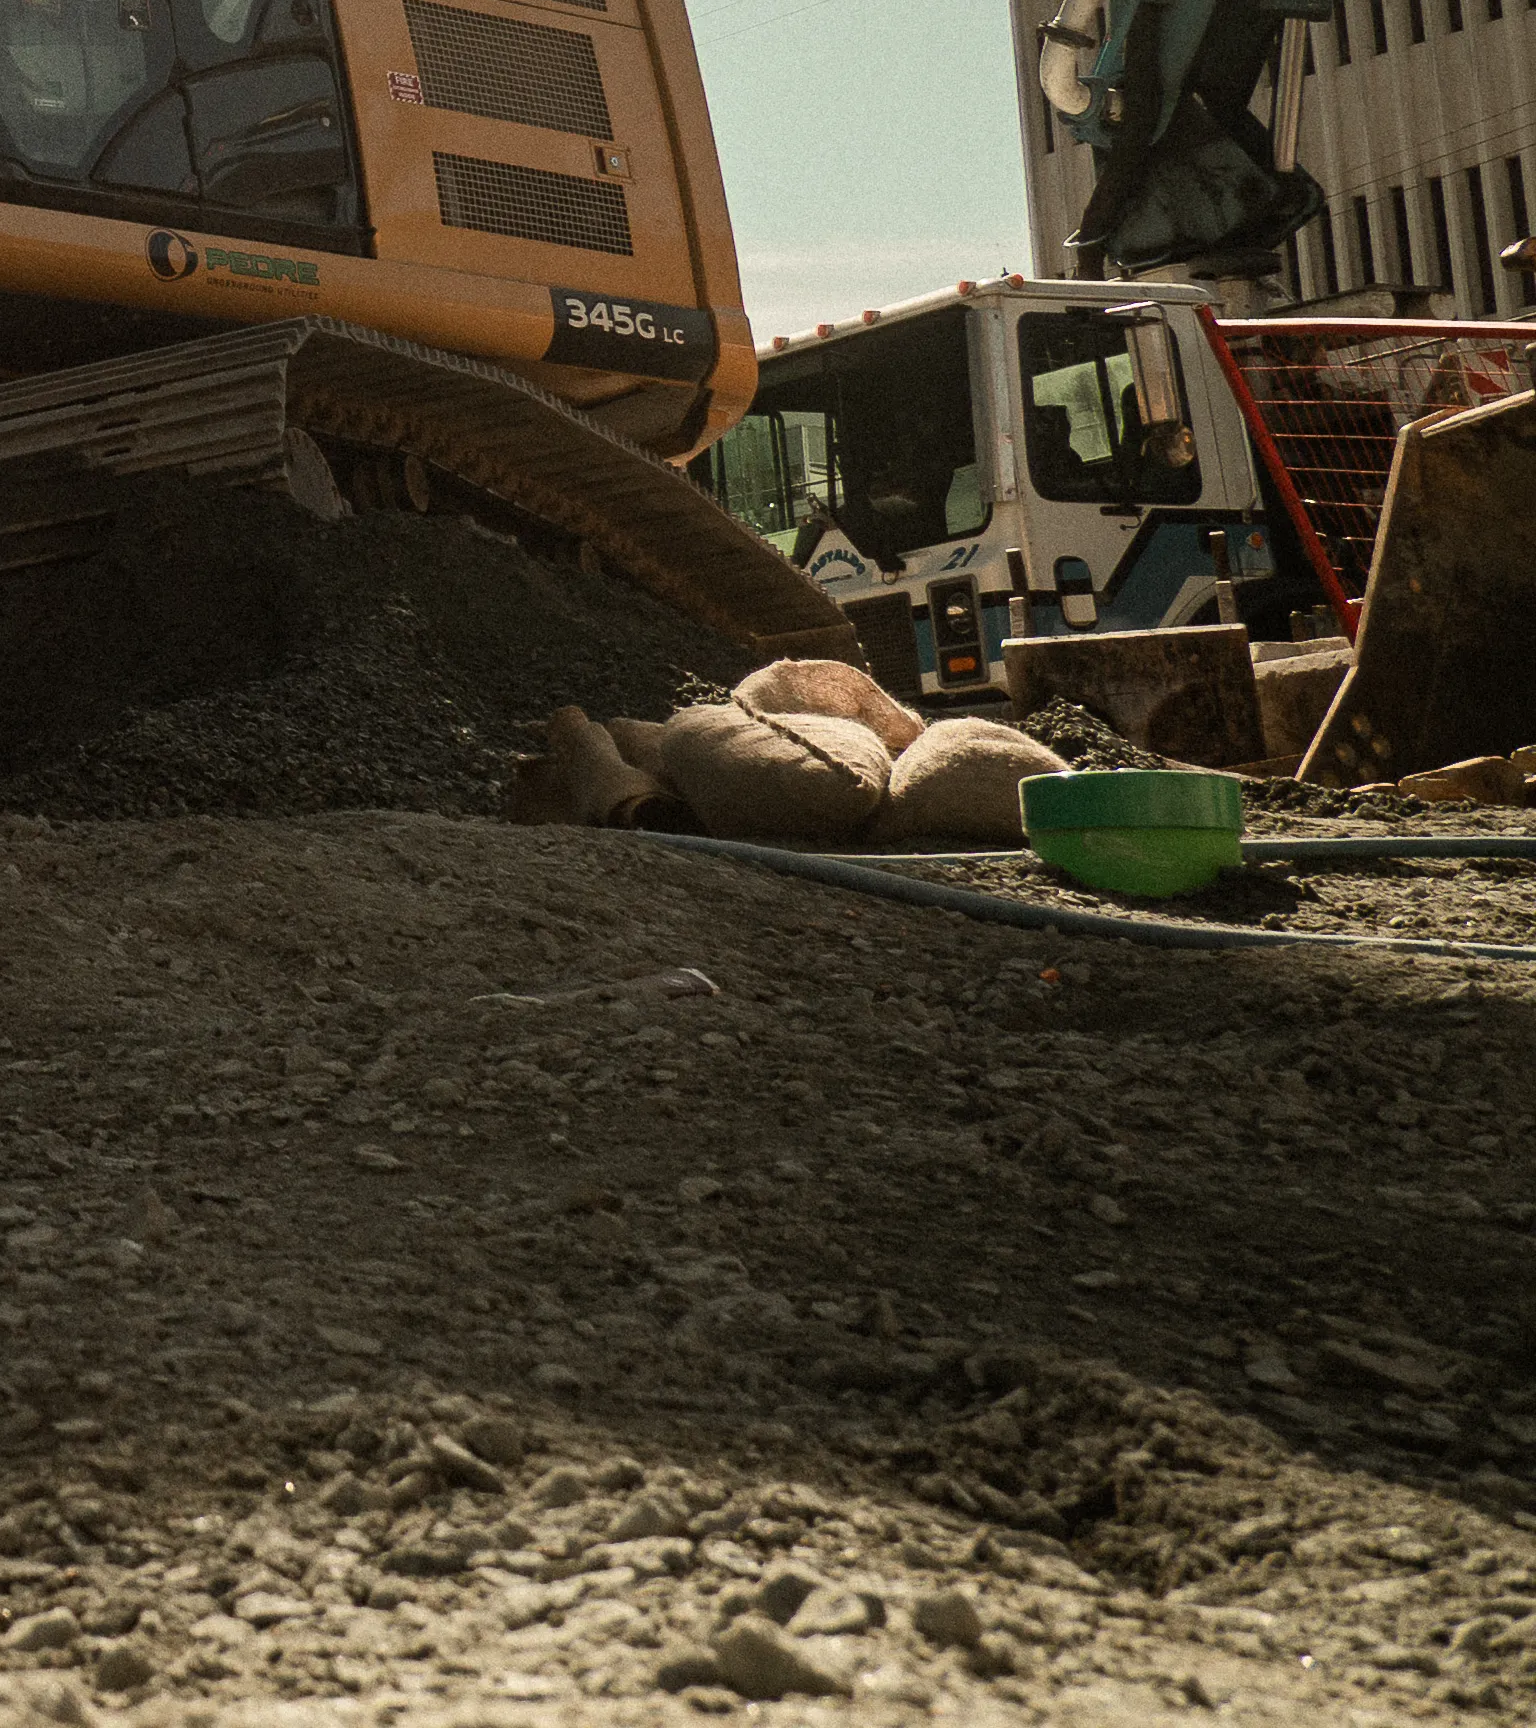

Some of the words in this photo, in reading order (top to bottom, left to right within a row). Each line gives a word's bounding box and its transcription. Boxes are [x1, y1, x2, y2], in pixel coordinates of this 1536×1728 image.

[205, 247, 320, 286] PEDRE
[565, 298, 657, 339] 345G
[663, 326, 685, 345] LC
[940, 543, 980, 571] 21
